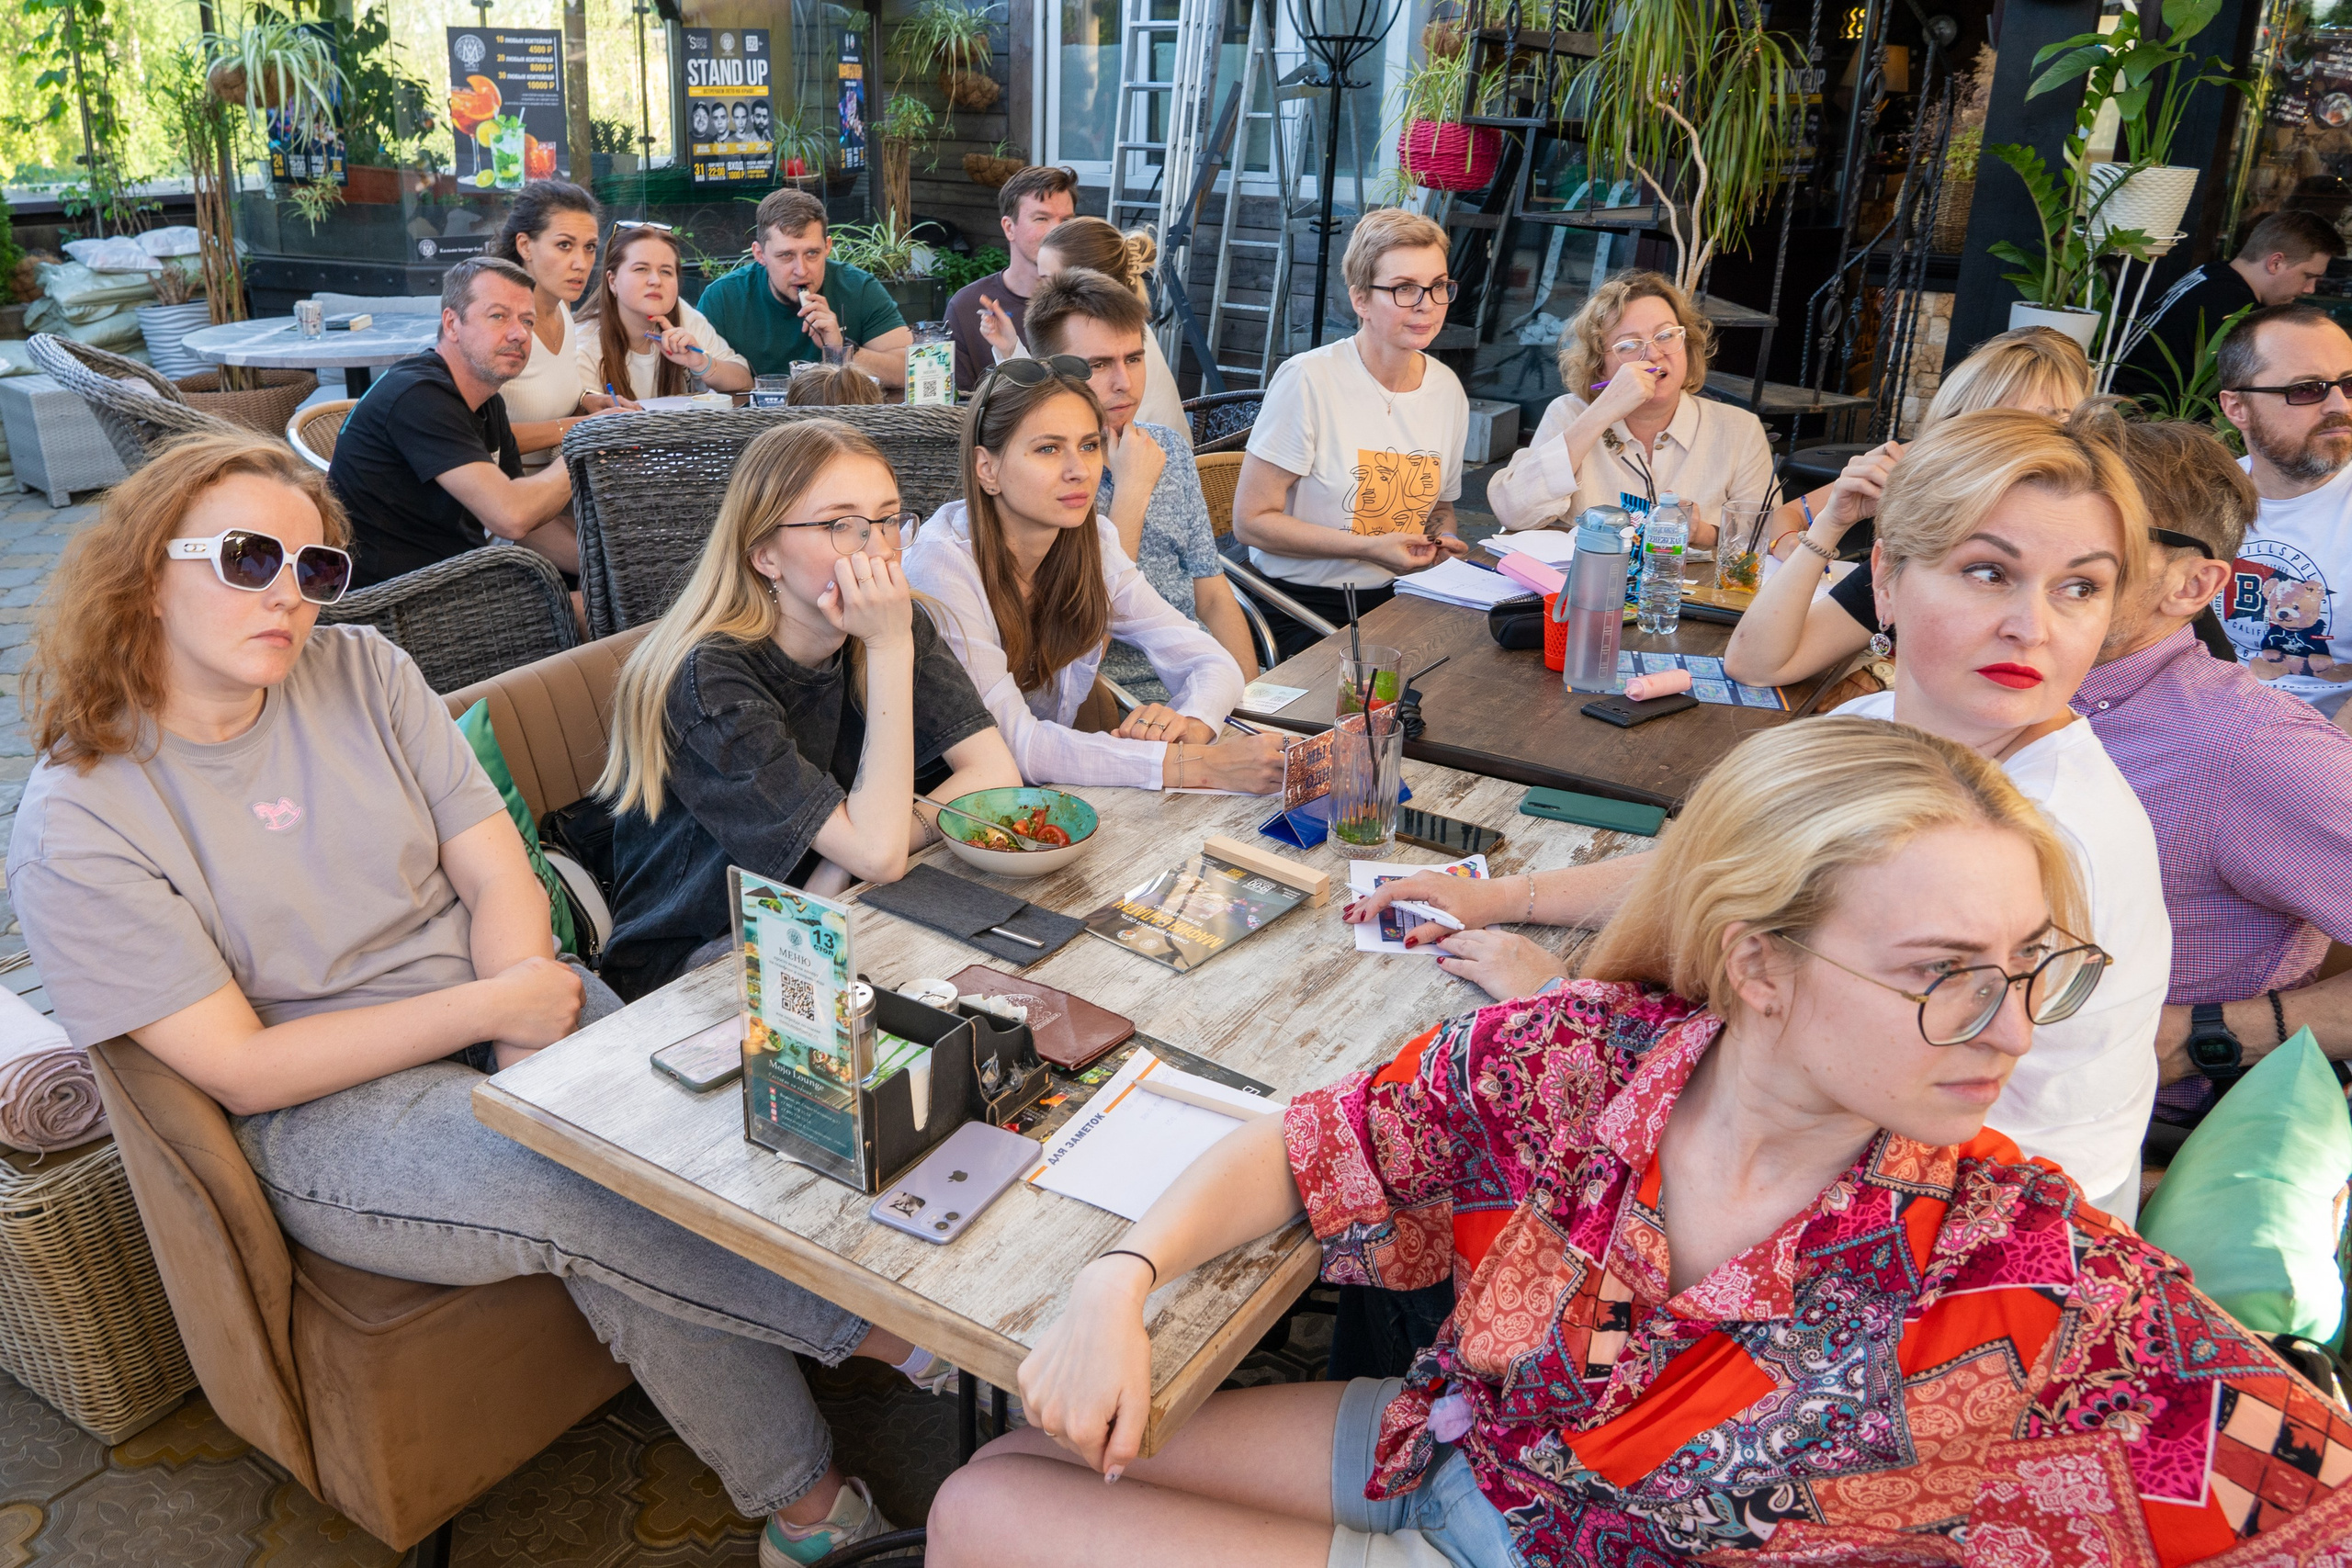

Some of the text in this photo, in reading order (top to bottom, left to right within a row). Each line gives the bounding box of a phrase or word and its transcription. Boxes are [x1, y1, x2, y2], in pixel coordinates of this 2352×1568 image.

[687, 59, 768, 85] STAND UP
[695, 163, 705, 175] 31
[2233, 571, 2262, 612] B
[1247, 879, 1273, 893] 19:00
[1112, 898, 1225, 950] МАФИЯ БАЛАГАН
[813, 929, 835, 950] 13
[778, 947, 811, 967] МЕНЮ
[768, 1059, 825, 1092] Mojo Lounge
[1066, 1111, 1106, 1151] ЗАМЕТОК
[1047, 1139, 1072, 1167] ДЛЯ
